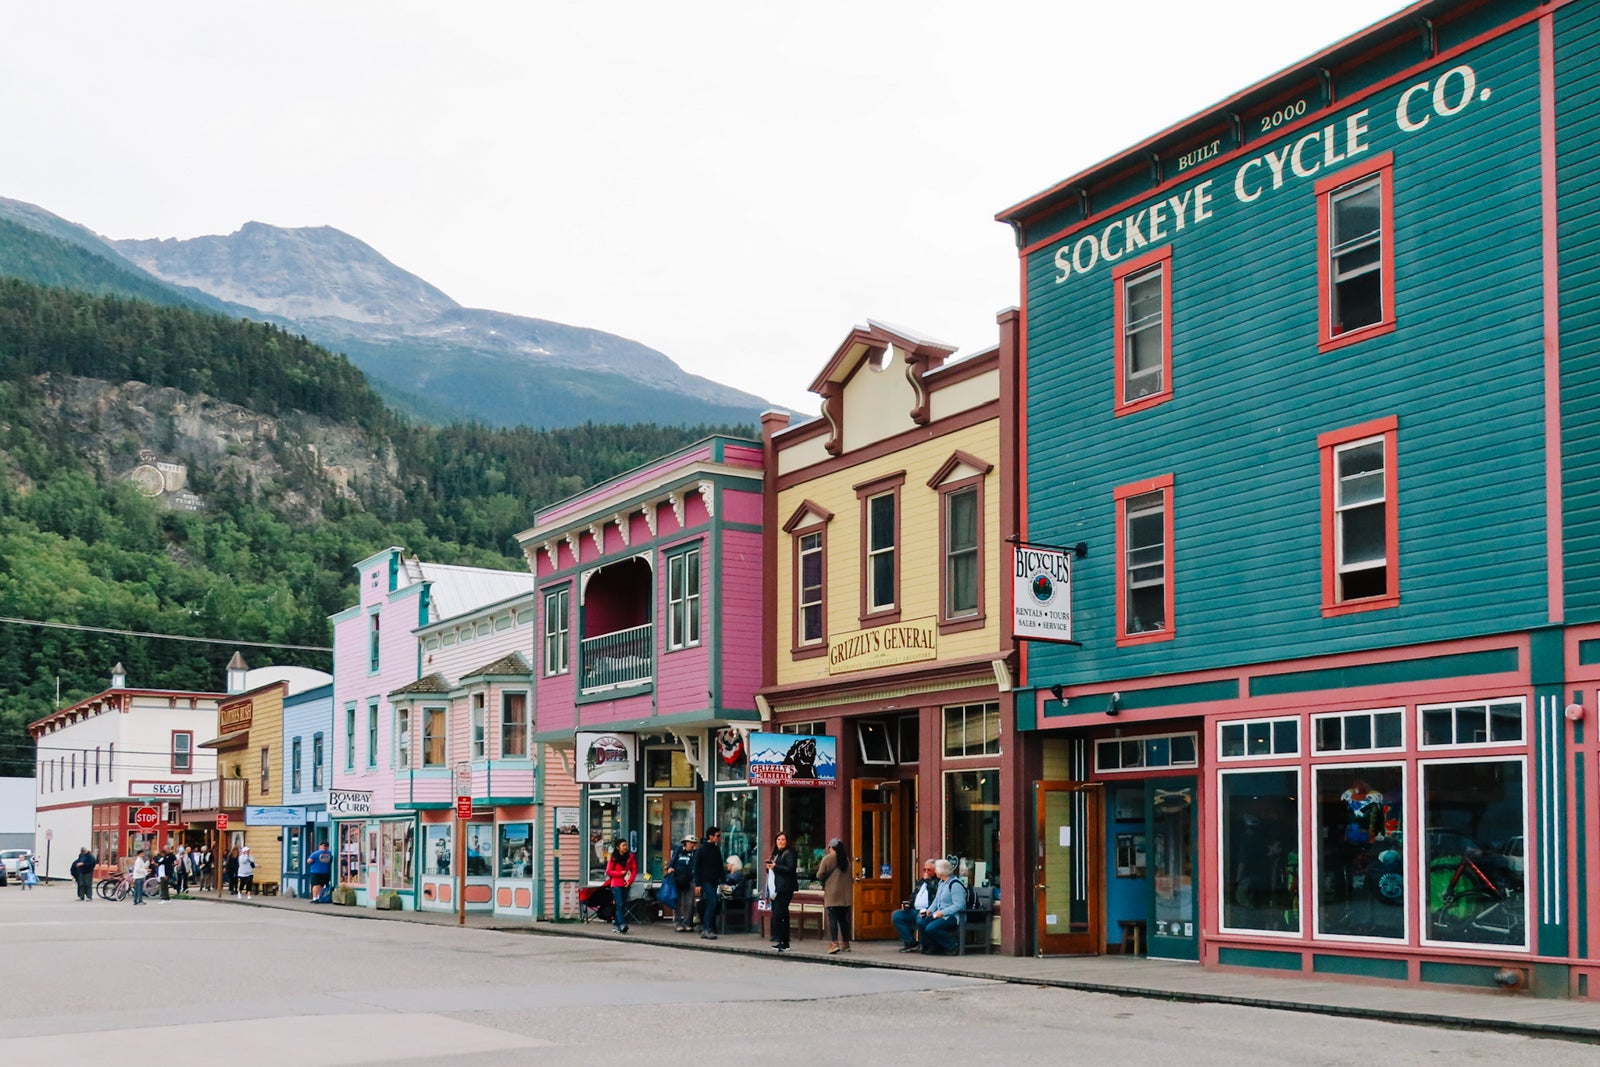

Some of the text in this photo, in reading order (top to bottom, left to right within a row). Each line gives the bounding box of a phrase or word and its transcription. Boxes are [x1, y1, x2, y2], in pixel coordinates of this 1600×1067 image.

[1178, 100, 1307, 171] BUILT 2000
[1054, 65, 1491, 284] SOCKEYE CYCLE CO.
[1016, 549, 1069, 583] BICYCLES
[1016, 607, 1070, 620] RENTALS TOURS
[1018, 619, 1067, 631] SALES SERVICE
[830, 627, 935, 665] GRIZZLY'S GENERAL
[329, 792, 371, 805] BOMBAY
[338, 801, 370, 812] CURRY
[137, 813, 157, 823] STOP
